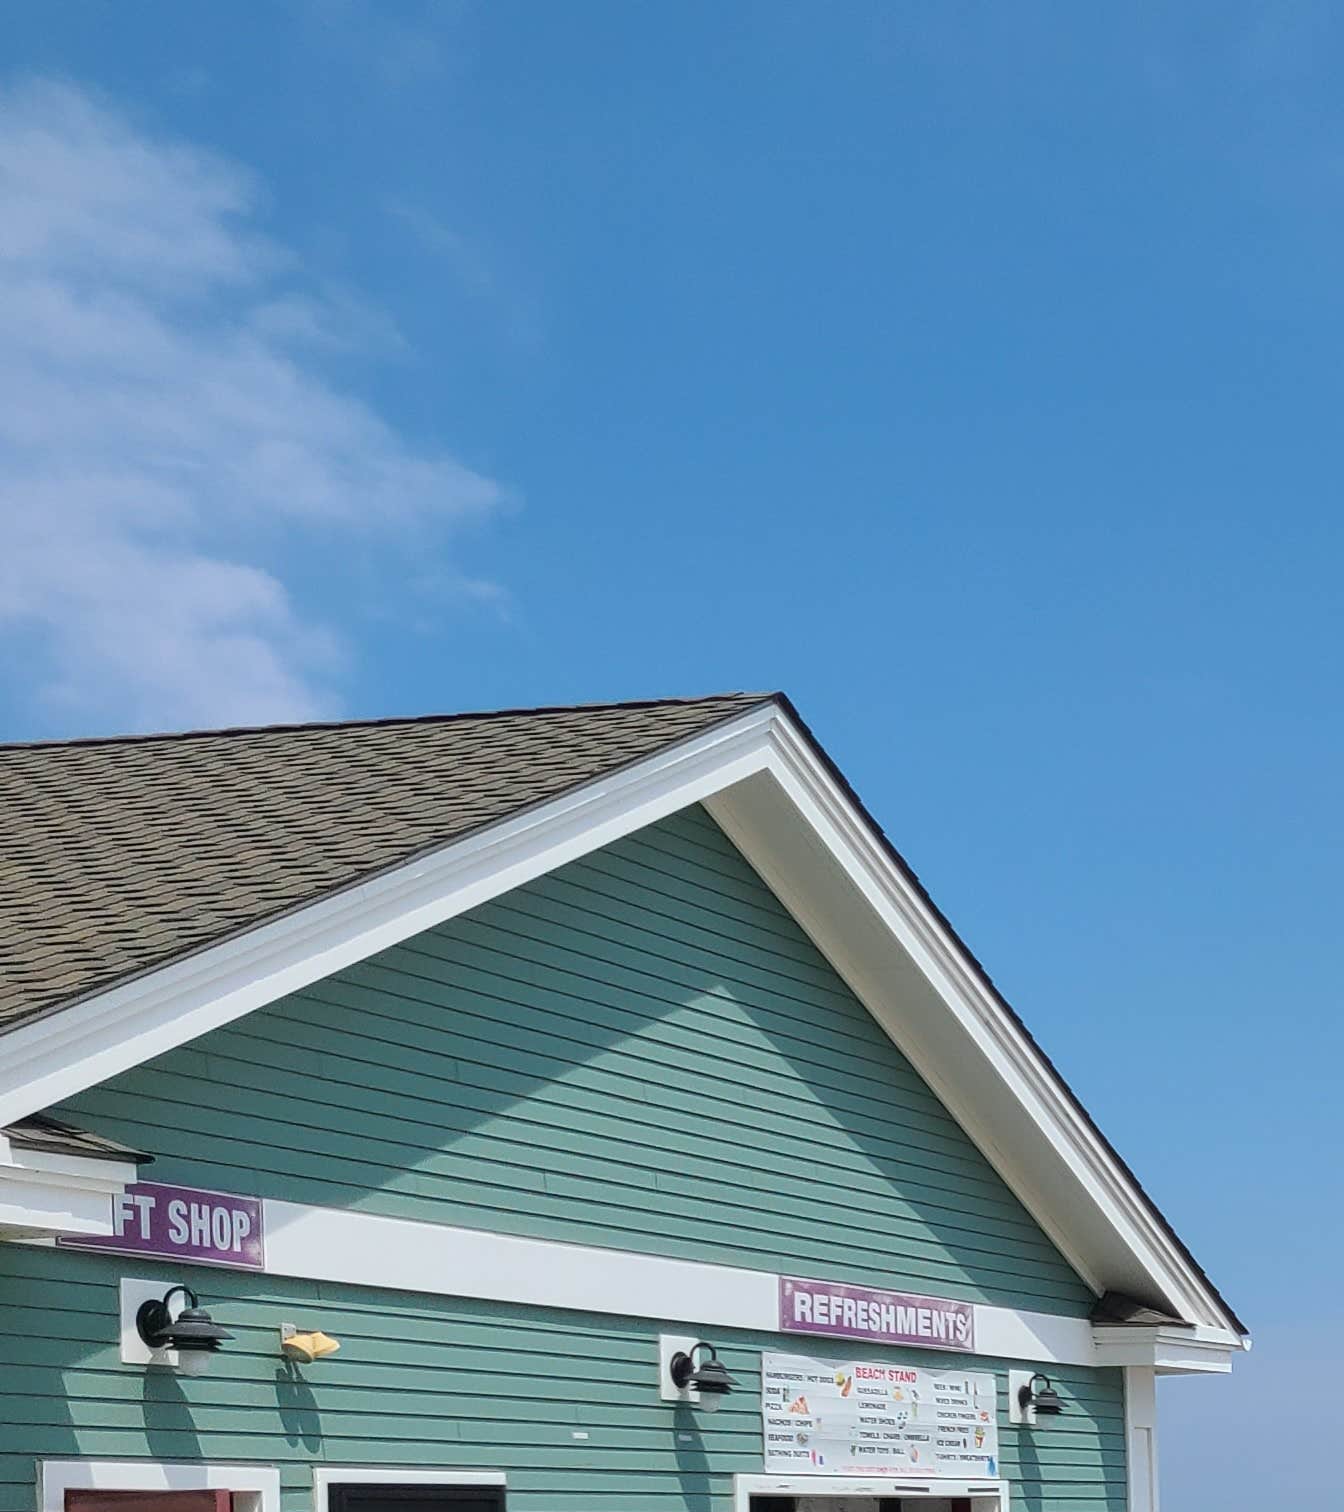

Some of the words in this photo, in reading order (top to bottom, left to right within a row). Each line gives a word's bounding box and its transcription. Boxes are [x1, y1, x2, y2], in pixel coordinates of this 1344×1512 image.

[114, 1193, 156, 1240] FT
[168, 1199, 250, 1252] SHOP
[793, 1291, 968, 1342] REFRESHMENTS
[855, 1367, 885, 1380] BEACH
[888, 1370, 917, 1383] STAND
